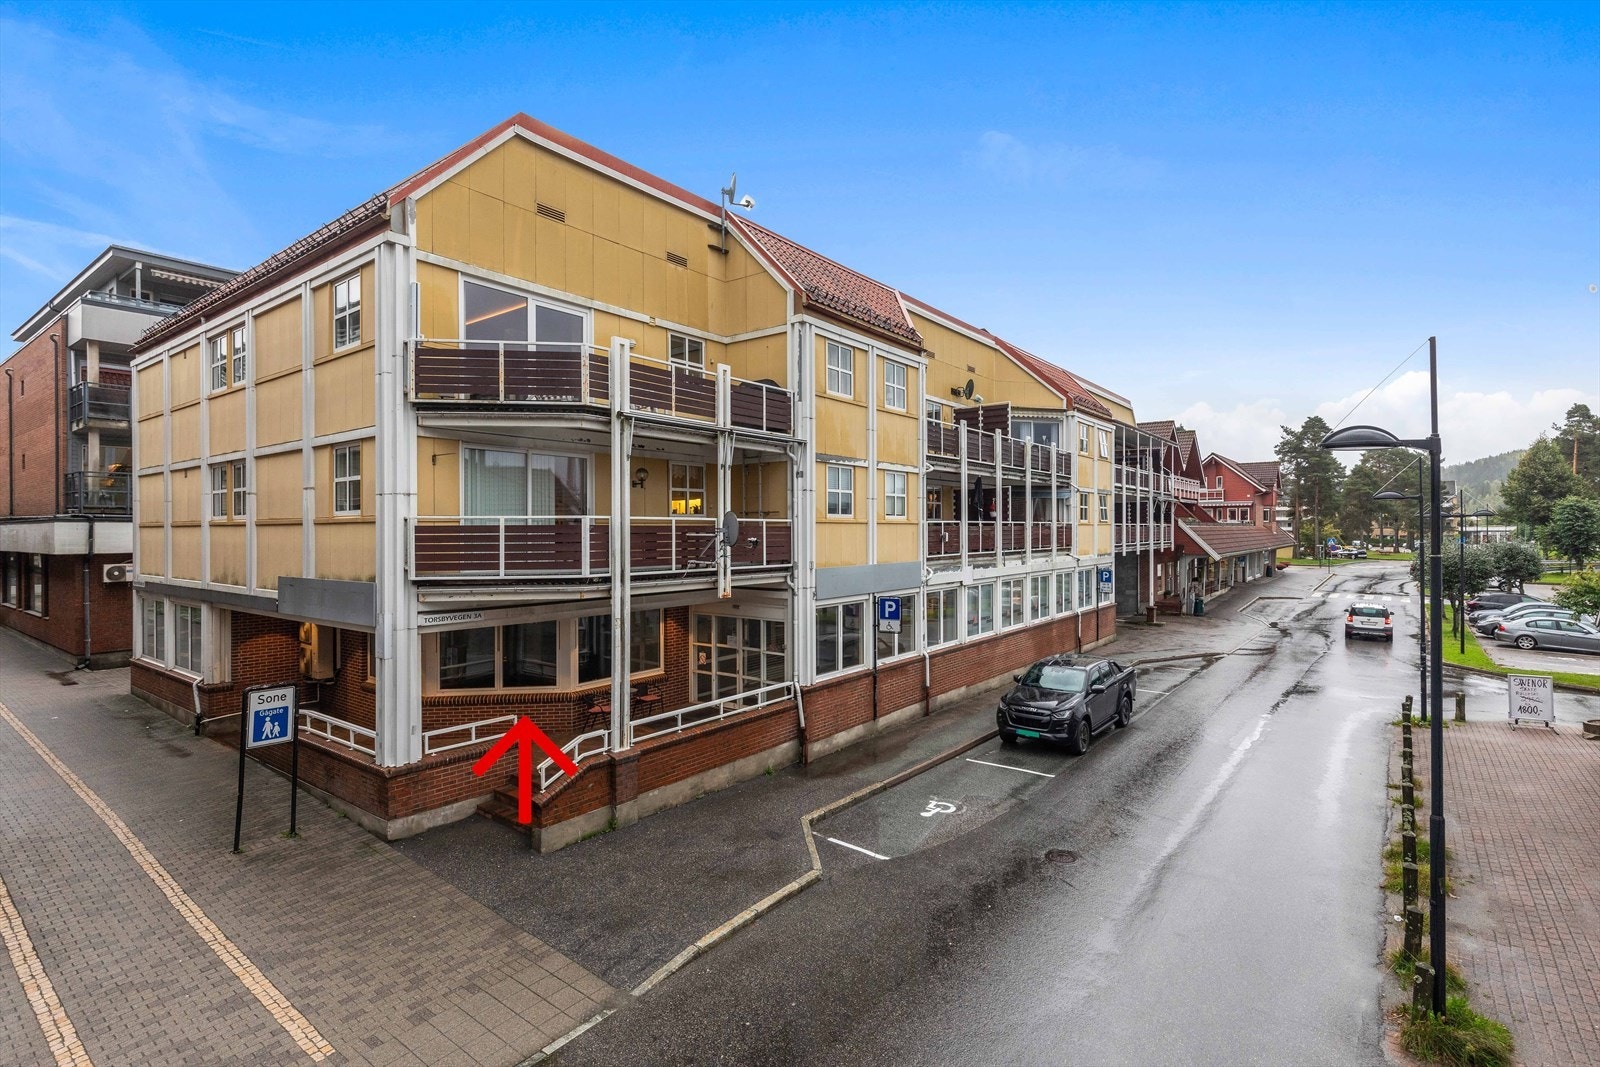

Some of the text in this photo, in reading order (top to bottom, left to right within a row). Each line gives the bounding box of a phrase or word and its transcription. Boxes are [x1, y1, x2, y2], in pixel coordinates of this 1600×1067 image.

[1103, 572, 1109, 581] P
[885, 601, 896, 617] P
[424, 614, 471, 623] TORSBYVEGEN
[1513, 678, 1547, 688] SWENOR
[257, 694, 287, 704] Sone
[259, 708, 284, 716] Gågate
